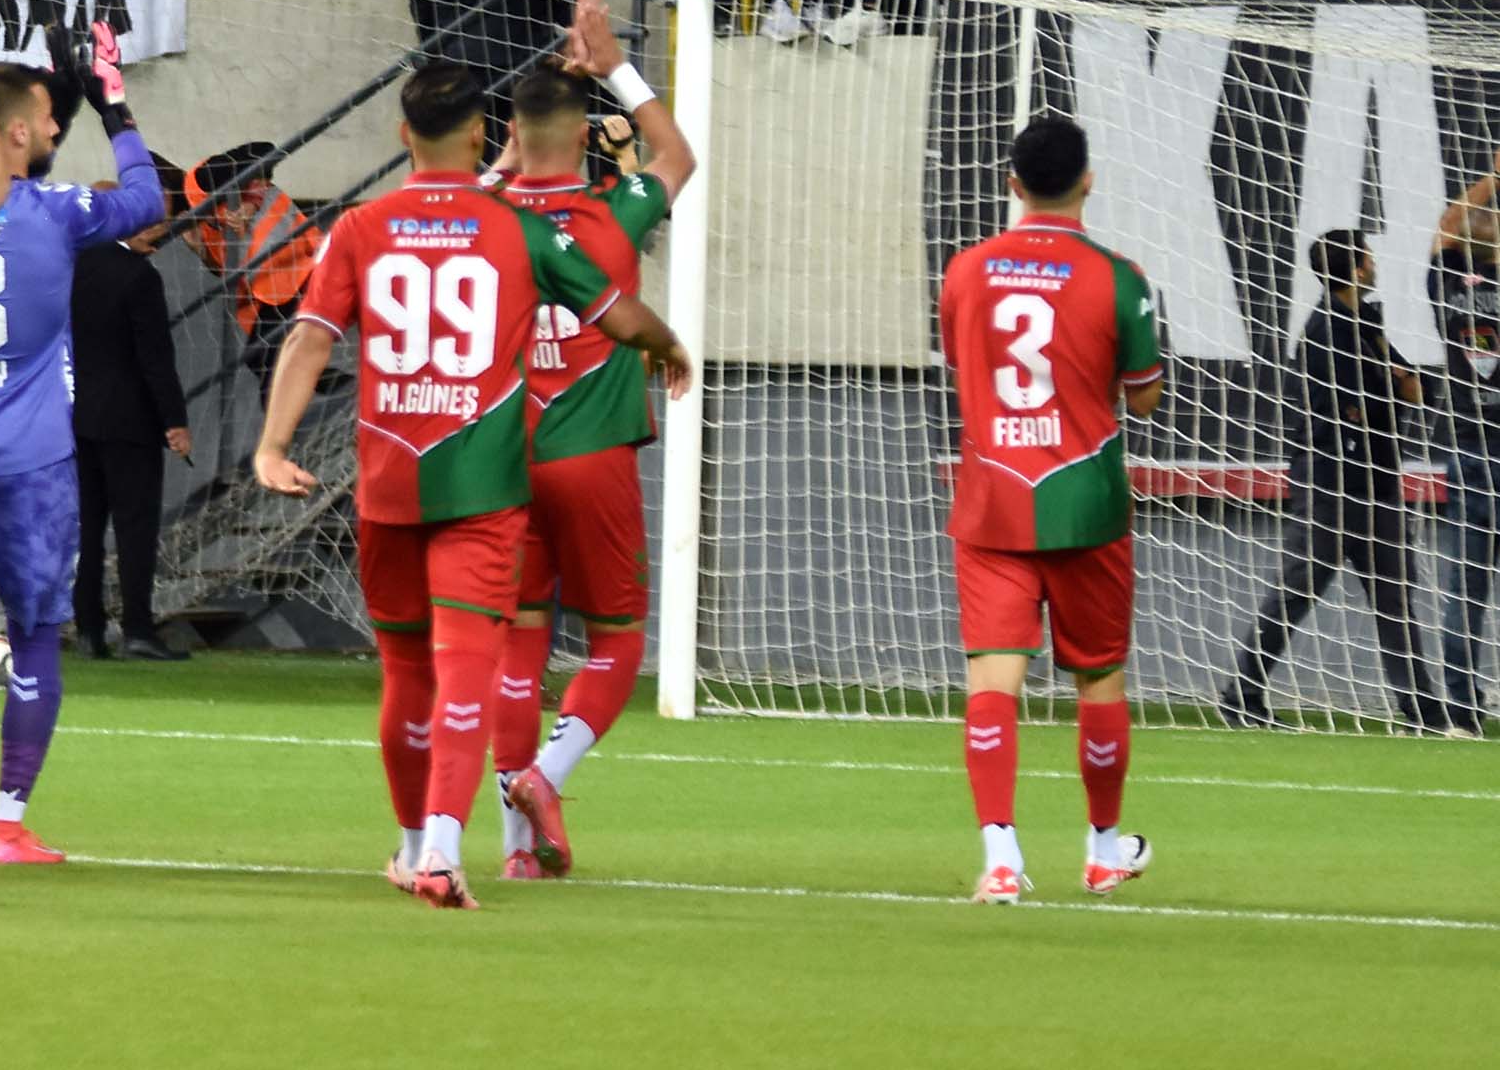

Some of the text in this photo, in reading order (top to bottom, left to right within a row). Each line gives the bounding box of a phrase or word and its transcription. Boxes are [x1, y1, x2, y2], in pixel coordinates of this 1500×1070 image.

[388, 218, 480, 235] TOLKAR
[985, 258, 1073, 279] TOLKAR
[367, 253, 499, 378] 99
[533, 341, 568, 370] OL
[994, 293, 1055, 410] 3
[378, 377, 480, 419] M.GÜNEŞ
[993, 409, 1062, 446] FERDİ
